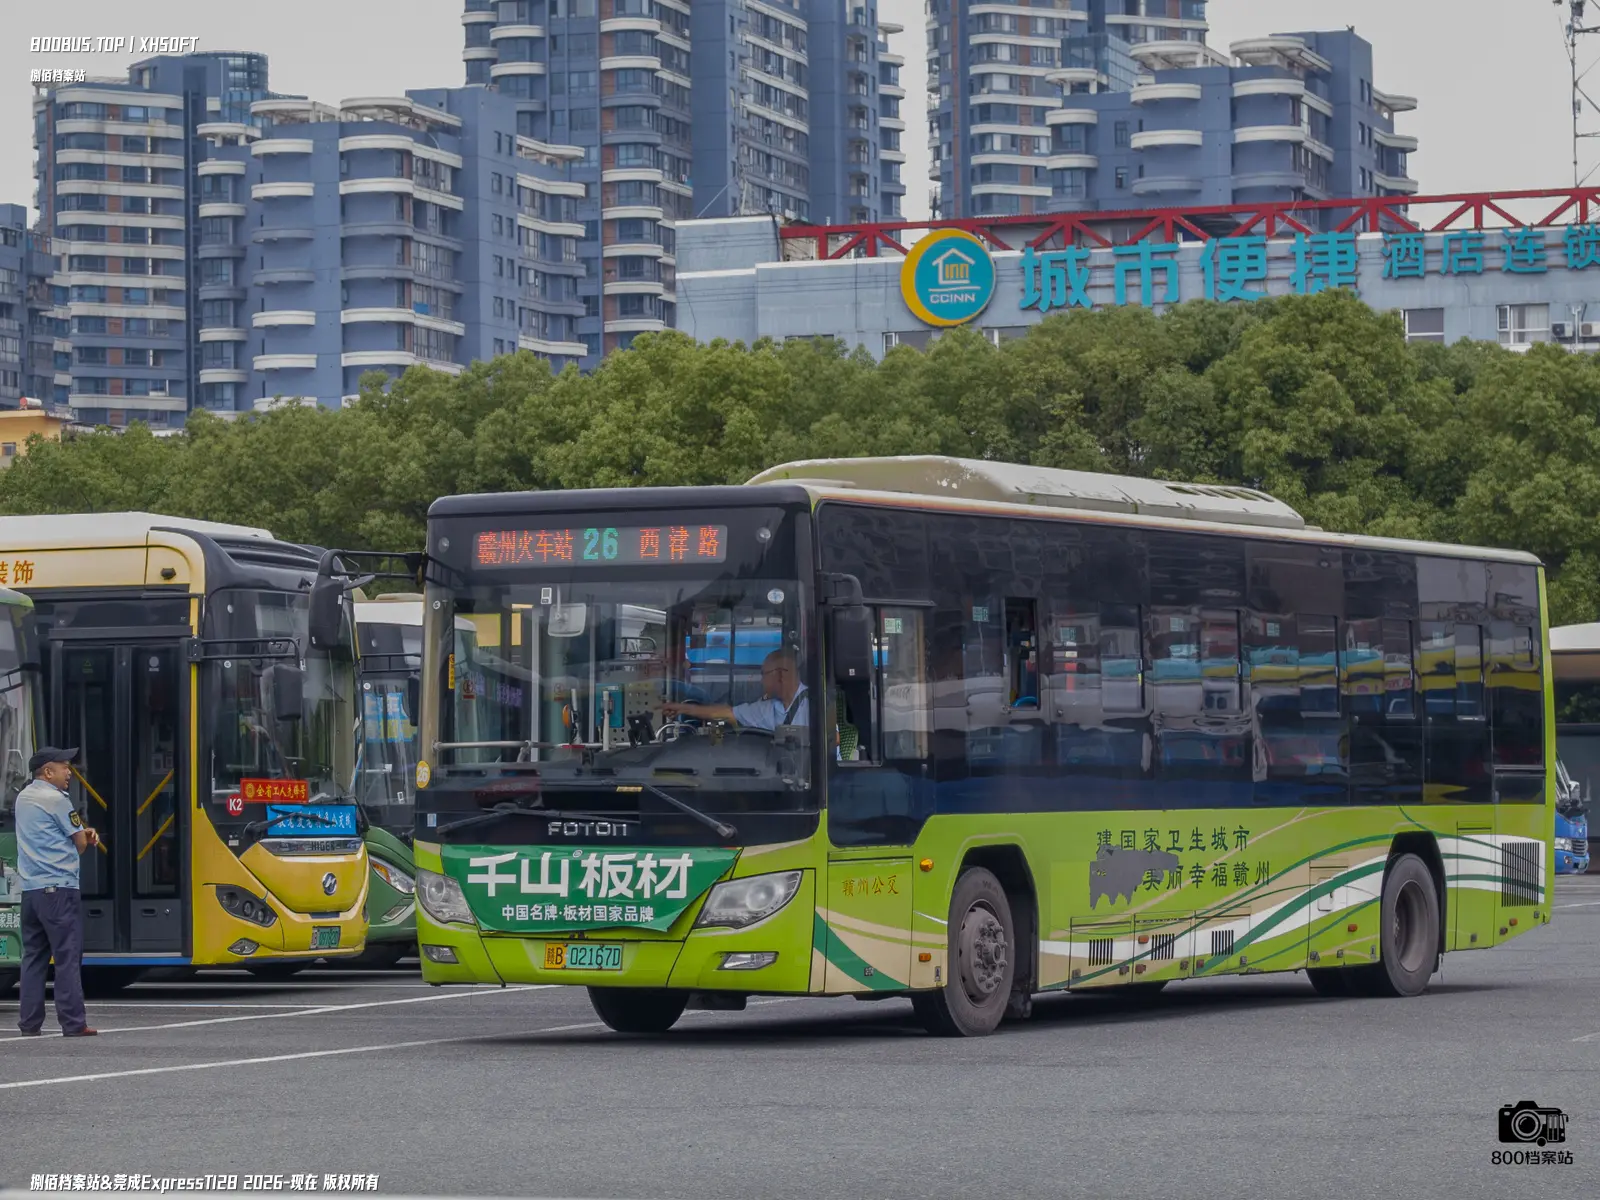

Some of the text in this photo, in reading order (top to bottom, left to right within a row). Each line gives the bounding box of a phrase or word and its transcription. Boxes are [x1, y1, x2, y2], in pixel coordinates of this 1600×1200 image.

[1018, 224, 1600, 313] 城市便捷 酒店连锁
[929, 292, 976, 304] CCINN
[477, 525, 720, 564] 赣州火车站 26 西津路
[417, 766, 429, 783] 26
[229, 798, 243, 811] K2
[1134, 860, 1271, 892] 美丽幸福赣州
[570, 947, 621, 966] 02167D
